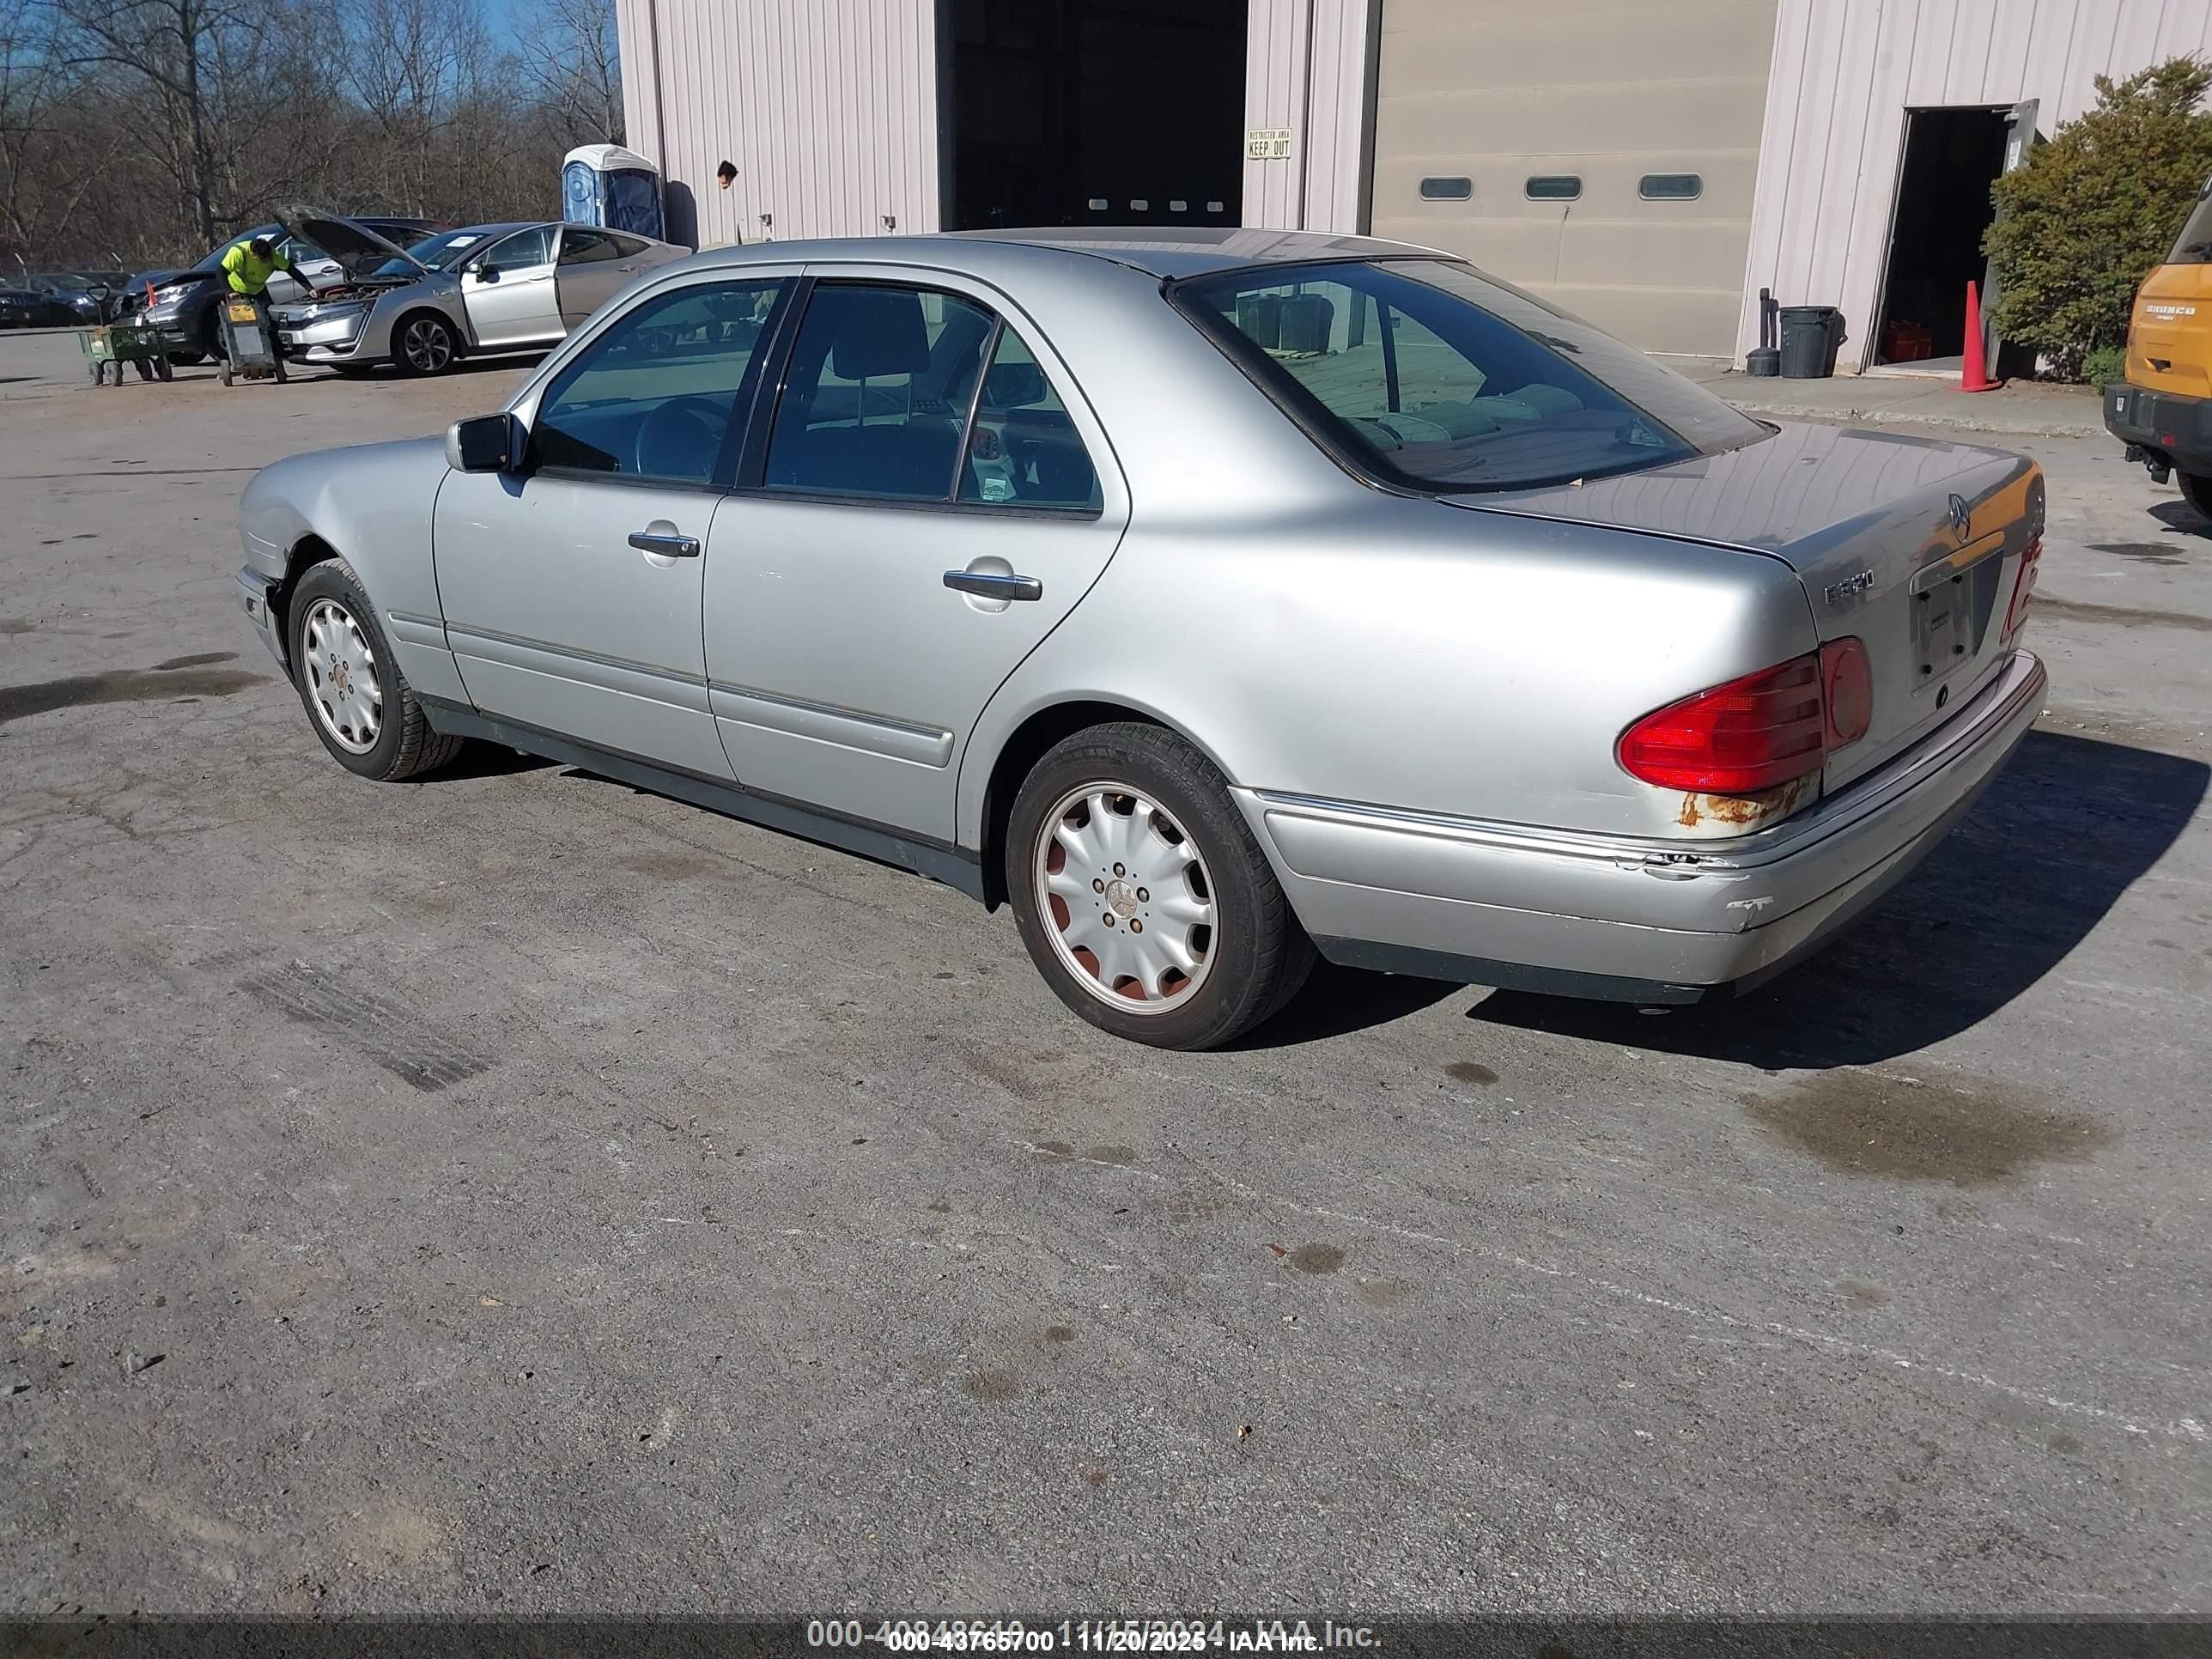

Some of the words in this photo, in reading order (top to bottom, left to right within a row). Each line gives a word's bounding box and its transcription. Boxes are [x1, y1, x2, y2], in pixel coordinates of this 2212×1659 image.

[1249, 131, 1275, 139] RESTRICTED
[1278, 130, 1289, 138] AREA
[1249, 140, 1268, 155] KEEP
[1273, 139, 1289, 155] OUT
